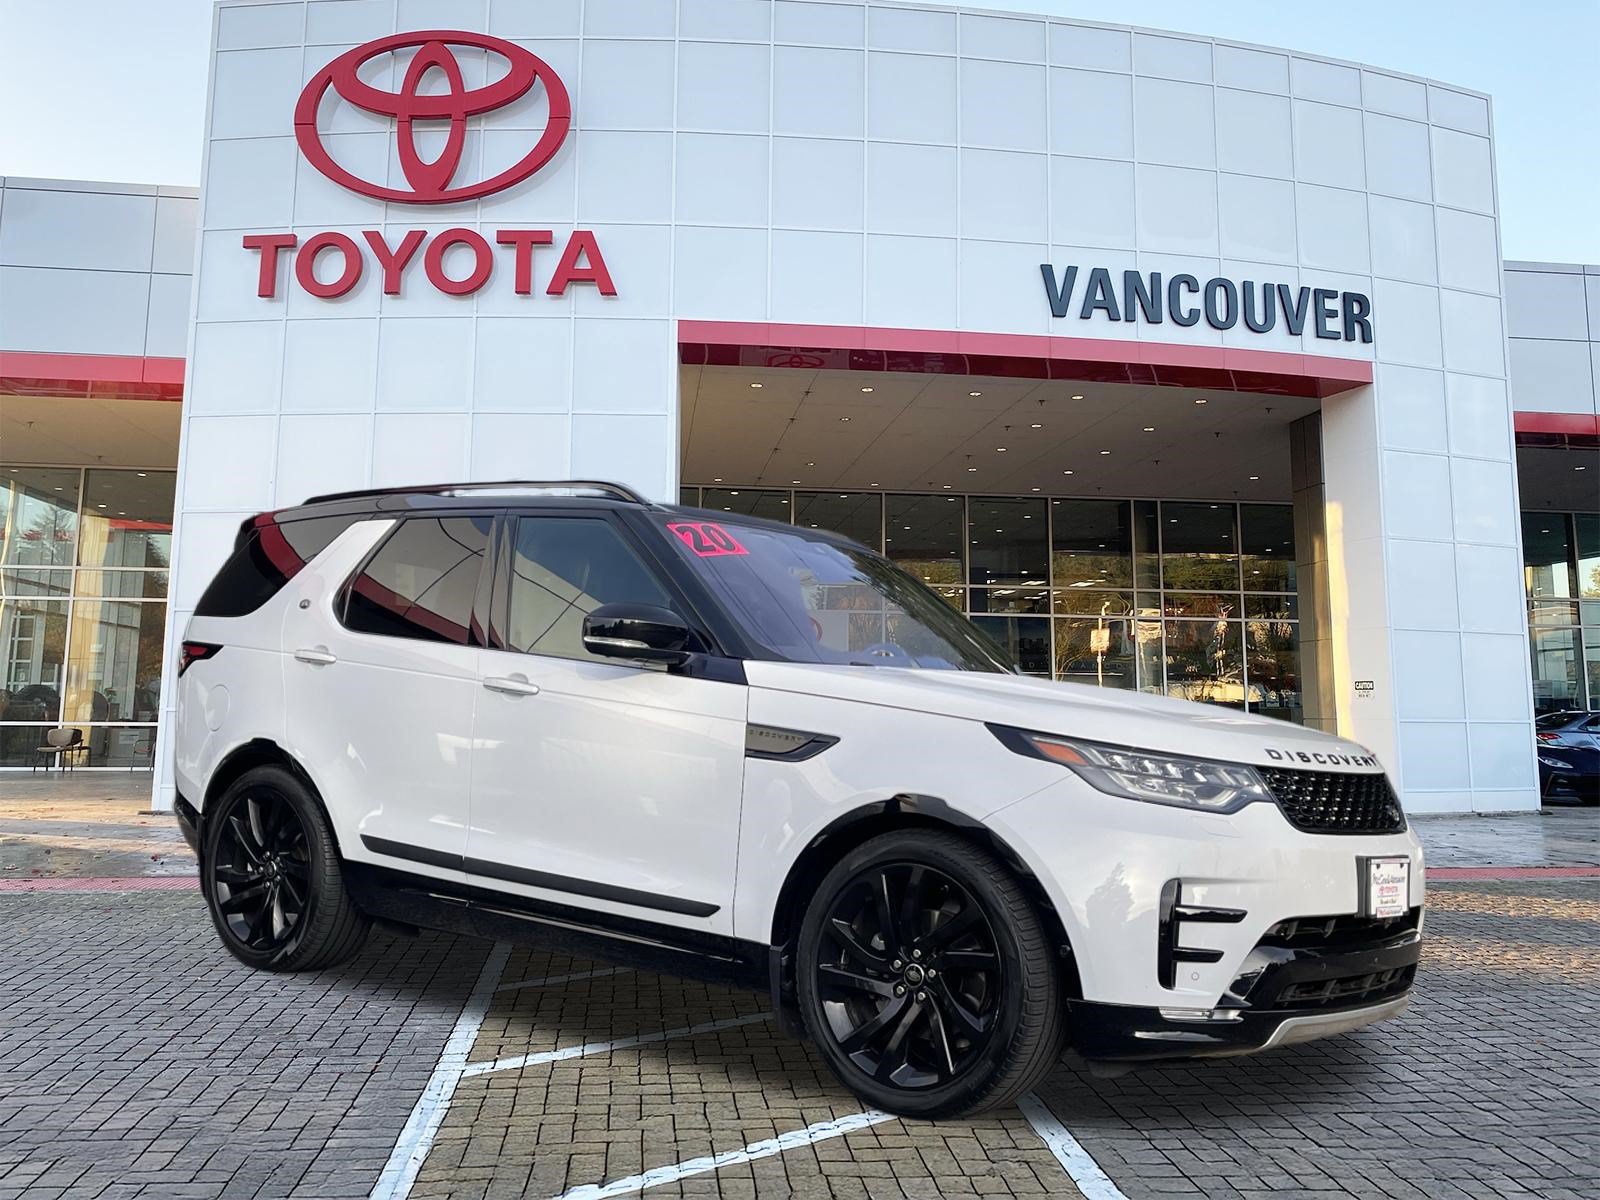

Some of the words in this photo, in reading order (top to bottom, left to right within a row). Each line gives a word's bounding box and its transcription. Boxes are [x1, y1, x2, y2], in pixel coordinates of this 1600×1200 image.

[243, 227, 618, 299] TOYOTA
[1040, 264, 1373, 344] VANCOUVER
[674, 525, 735, 552] 20
[1264, 748, 1378, 767] DISCOVERY
